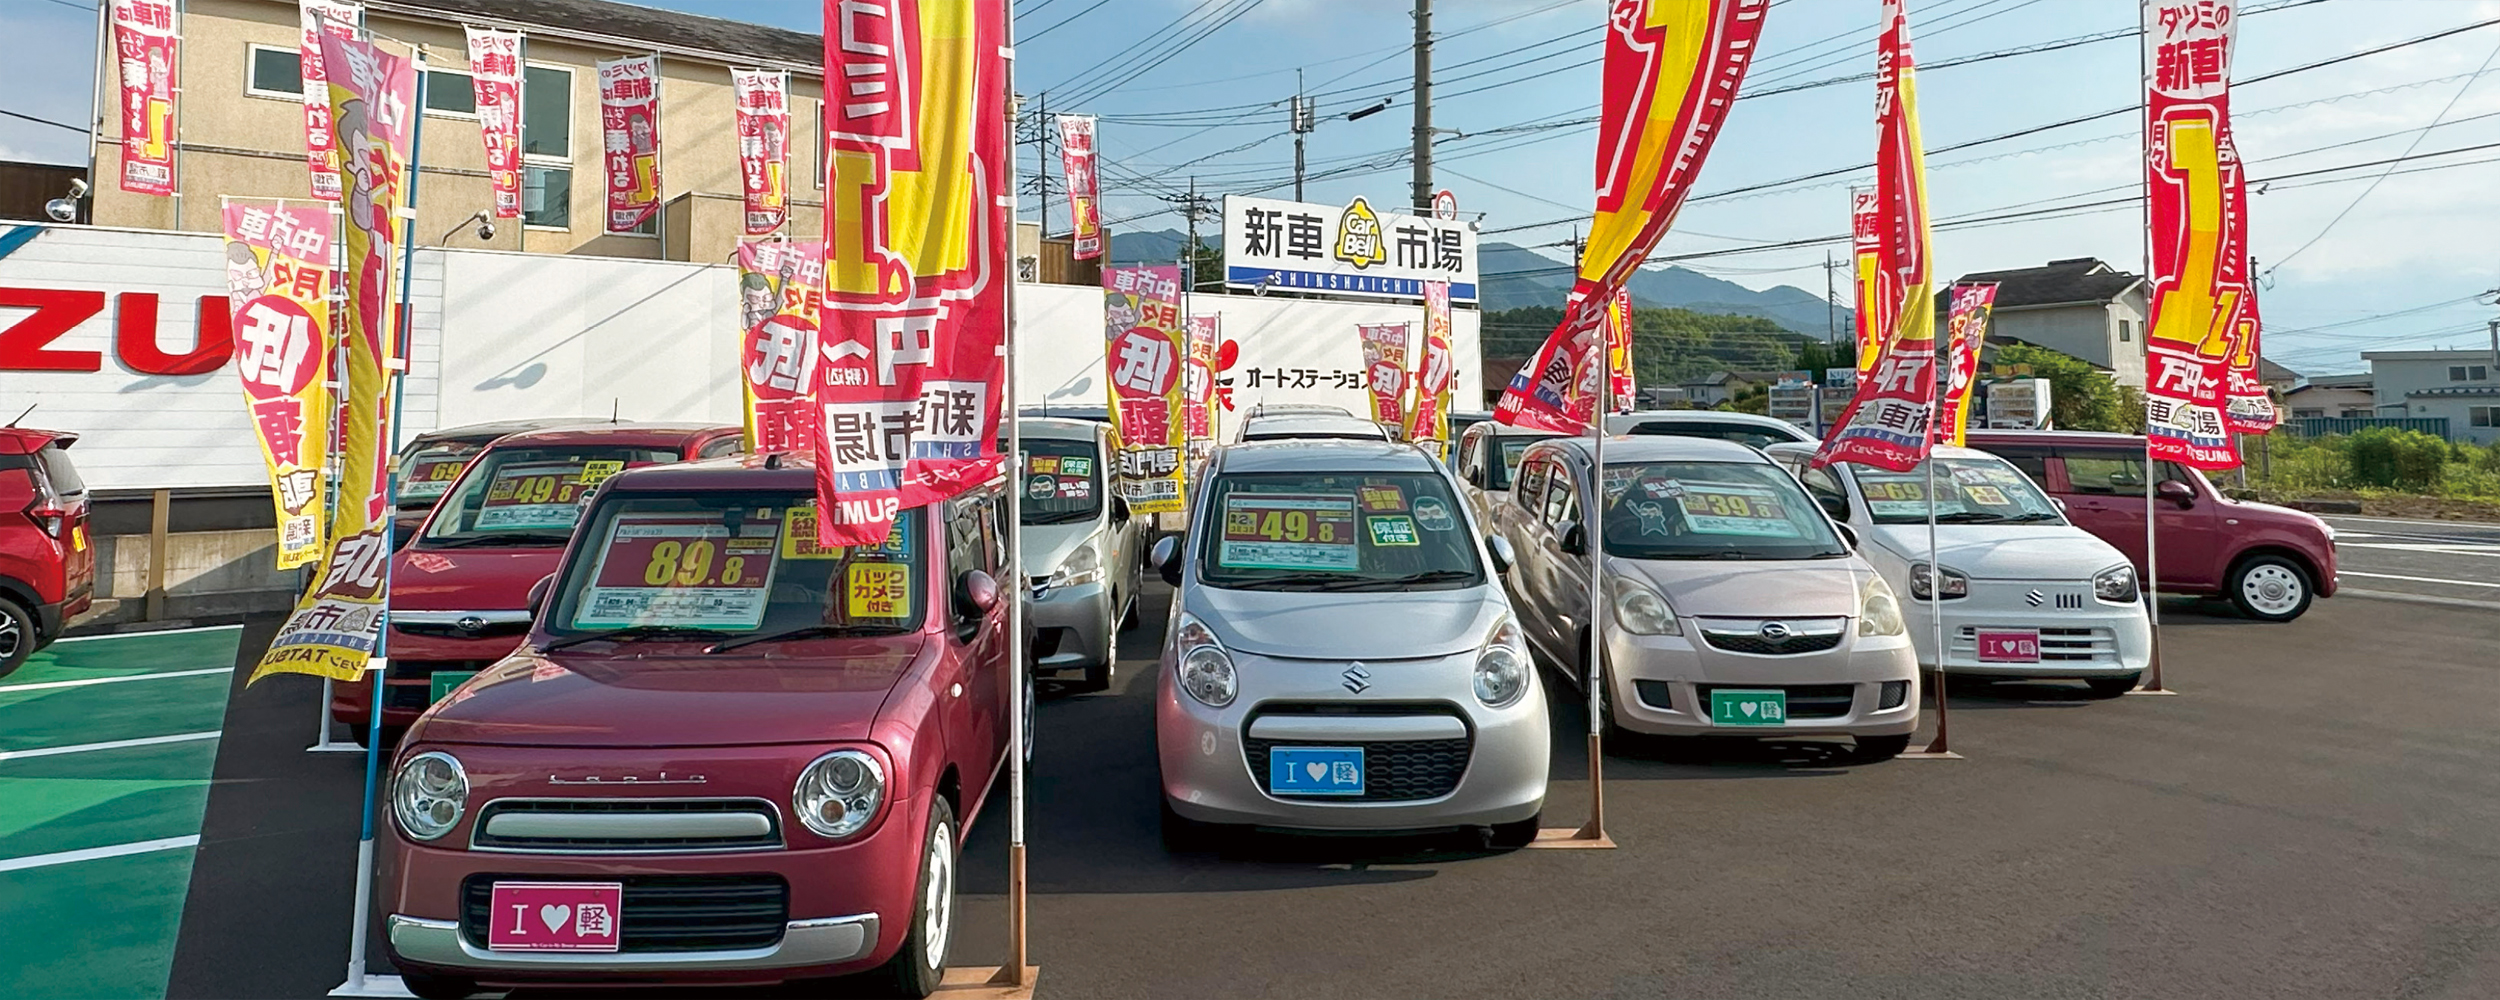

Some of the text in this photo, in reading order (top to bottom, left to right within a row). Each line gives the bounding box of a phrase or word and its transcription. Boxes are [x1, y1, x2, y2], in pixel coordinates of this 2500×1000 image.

[2157, 1, 2230, 39] タツミの
[1440, 200, 1453, 217] 30
[1345, 213, 1376, 237] Car
[1244, 206, 1463, 273] 新車 市場
[1343, 234, 1377, 259] Bell
[1274, 271, 1424, 294] SHINSHAICHIB
[513, 475, 574, 505] 49.8
[1707, 495, 1774, 519] 39.8
[790, 517, 817, 538] 総
[1259, 511, 1335, 543] 49.8
[1372, 521, 1413, 534] 保証
[1382, 533, 1409, 543] 付き
[644, 540, 745, 586] 89.8
[854, 569, 905, 585] バック
[854, 584, 905, 600] カメラ
[866, 601, 893, 613] 付き
[579, 905, 606, 932] 軽
